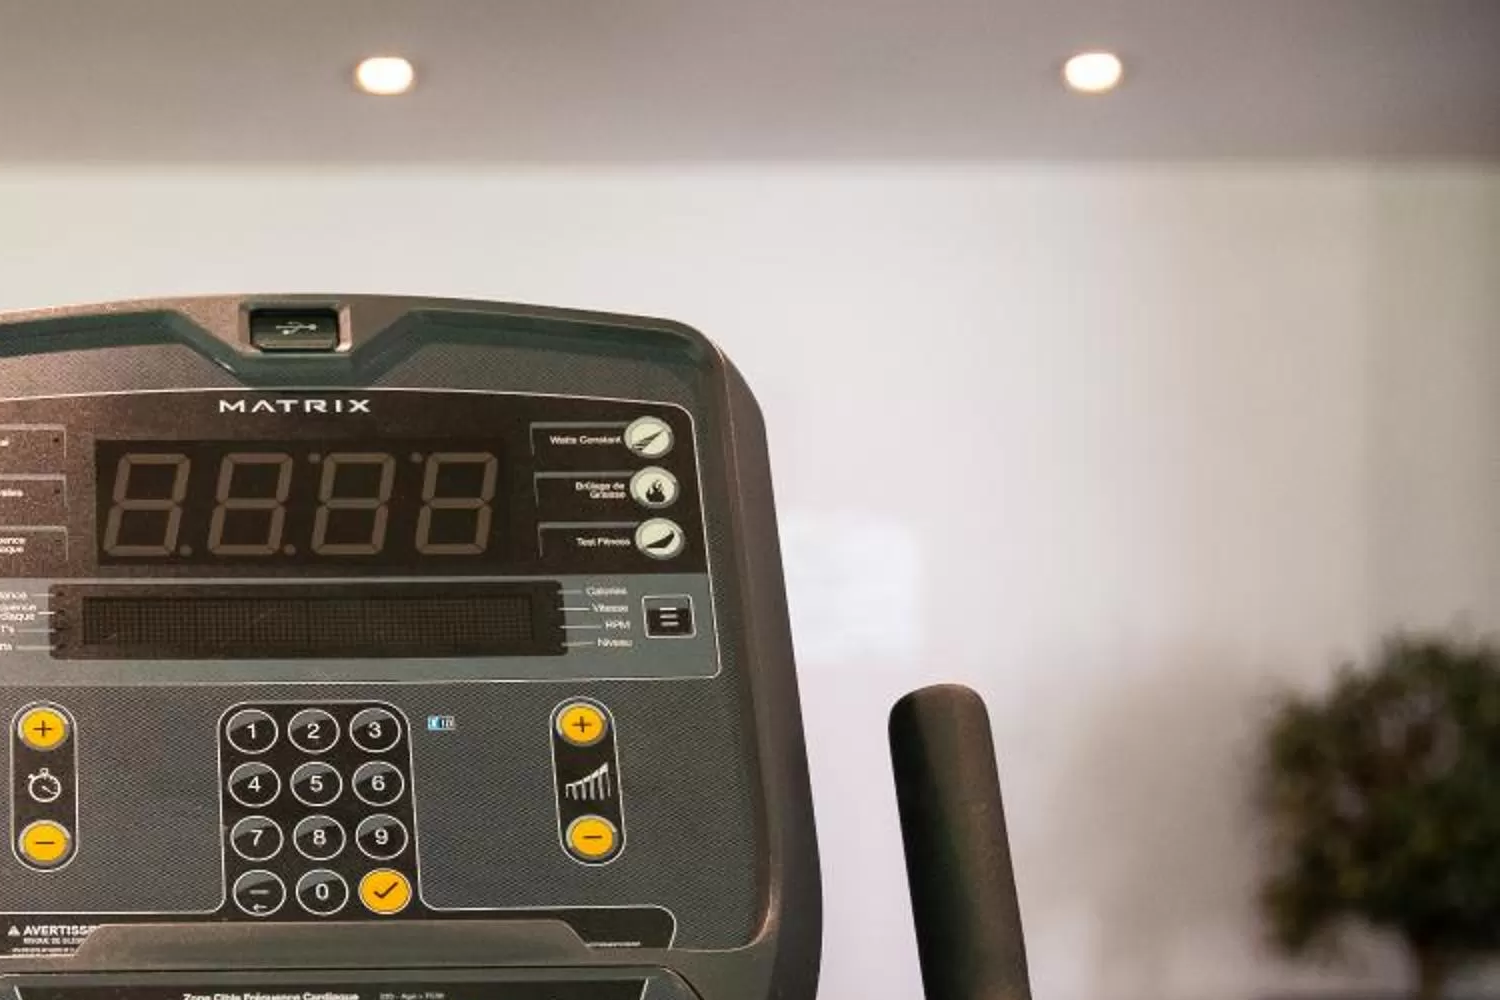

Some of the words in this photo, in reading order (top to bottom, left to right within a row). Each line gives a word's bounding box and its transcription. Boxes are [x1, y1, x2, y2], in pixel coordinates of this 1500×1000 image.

[219, 399, 371, 413] MATRIX
[605, 620, 631, 631] RPM
[246, 723, 256, 740] 1
[306, 723, 321, 740] 2
[368, 722, 382, 739] 3
[247, 775, 261, 793] 4
[309, 775, 324, 793] 5
[371, 775, 386, 792] 6
[251, 829, 263, 847] 7
[313, 829, 327, 846] 8
[375, 829, 389, 845] 9
[315, 883, 330, 900] 0
